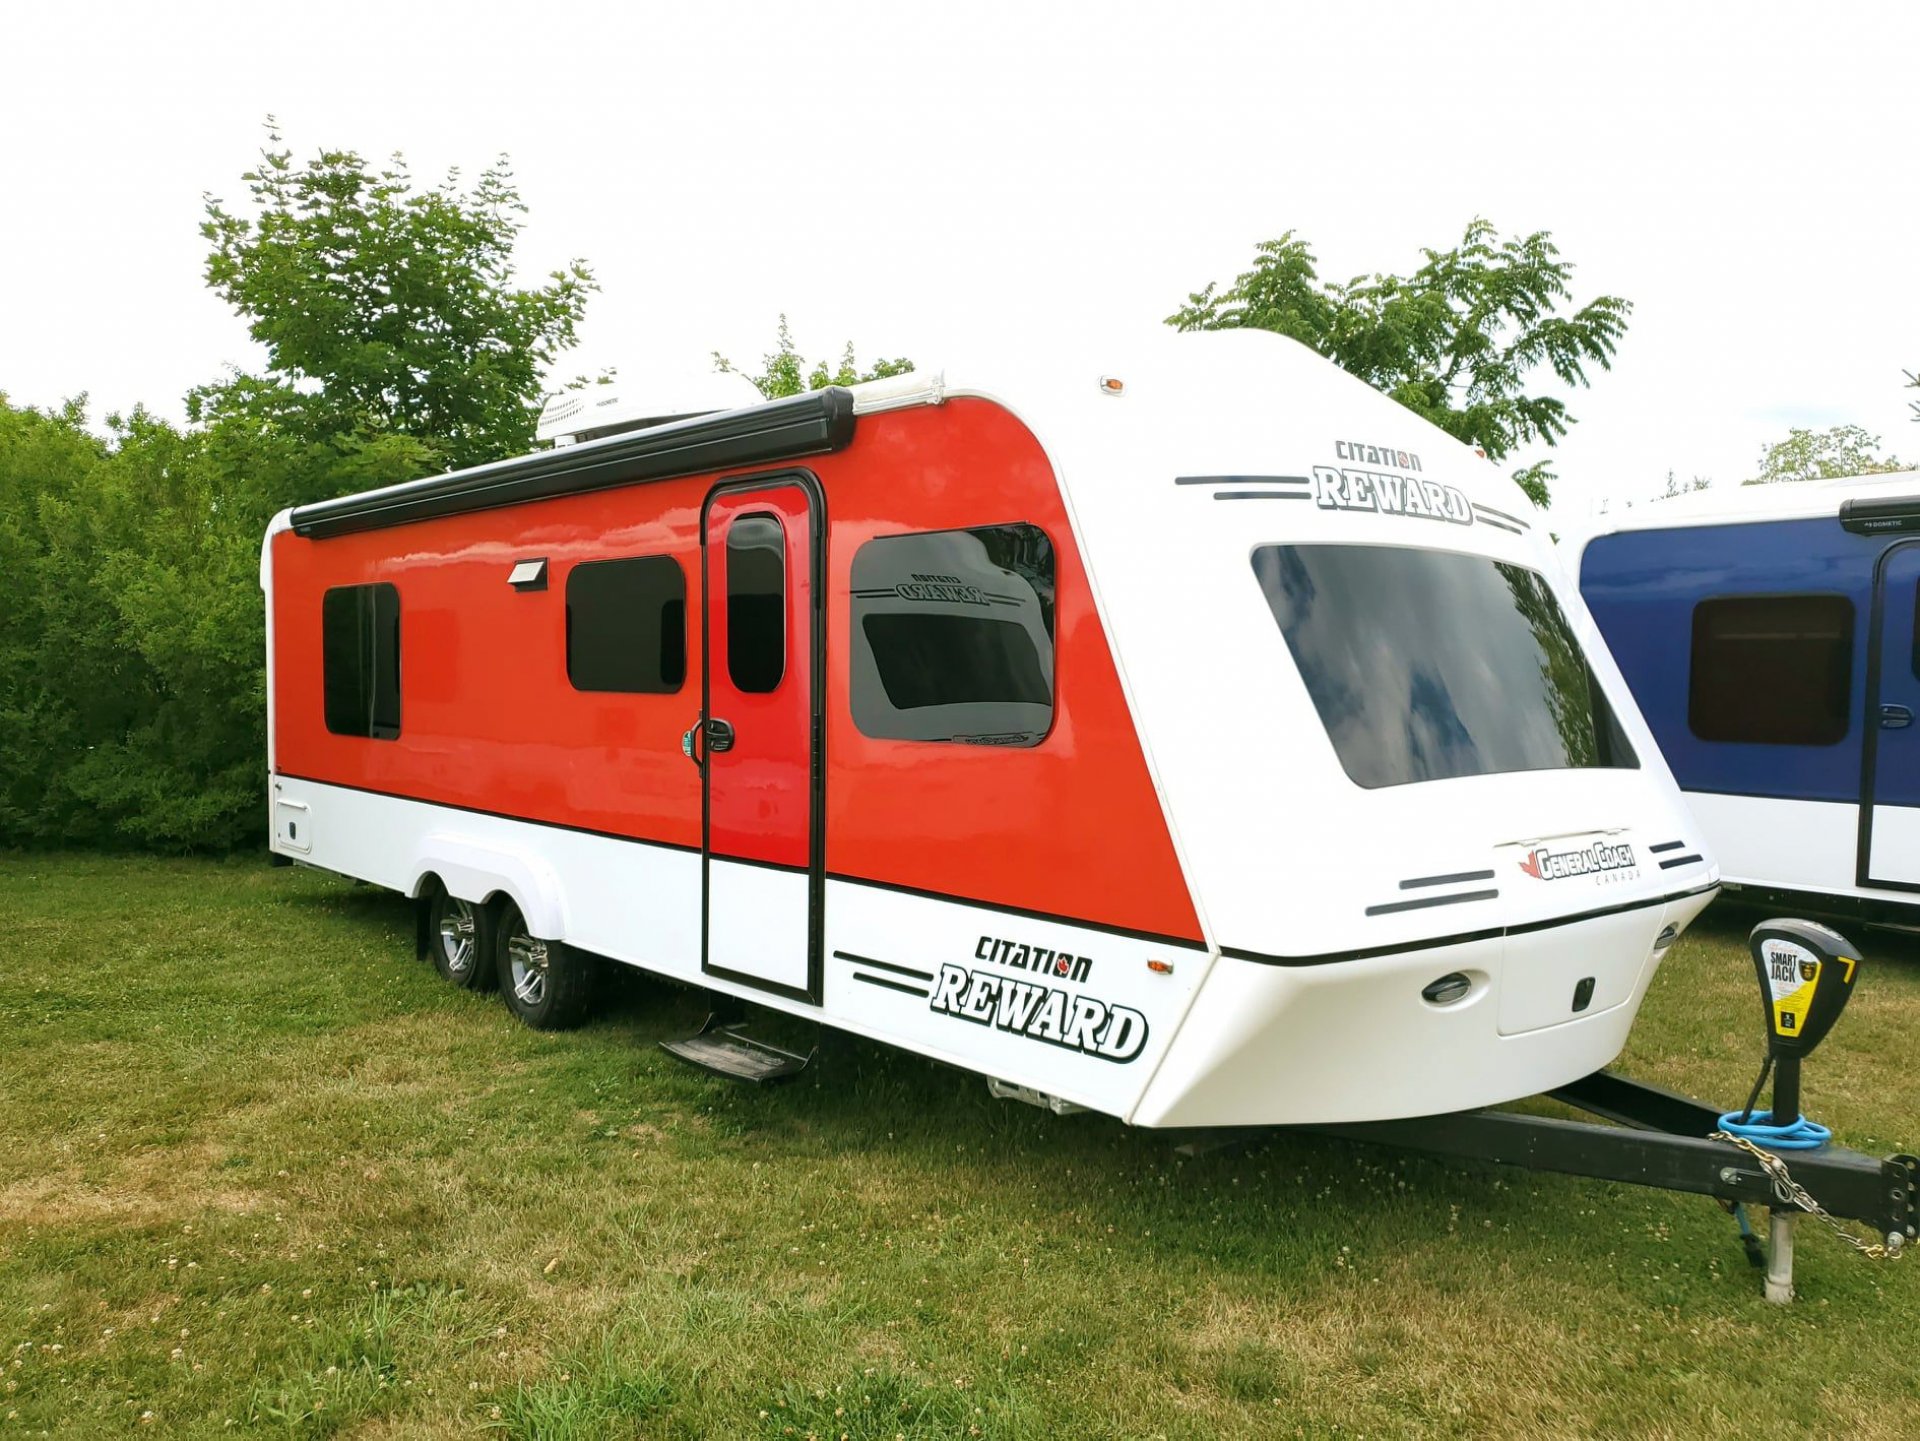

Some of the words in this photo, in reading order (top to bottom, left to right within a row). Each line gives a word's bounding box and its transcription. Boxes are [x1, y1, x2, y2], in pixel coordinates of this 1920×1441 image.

[1335, 440, 1422, 472] CITATION
[1313, 465, 1474, 526] REWARD
[1596, 869, 1641, 886] CANADA
[975, 936, 1093, 983] CITATION
[1770, 952, 1797, 967] SMART
[1771, 964, 1796, 983] JACK
[930, 963, 1149, 1065] REWARD
